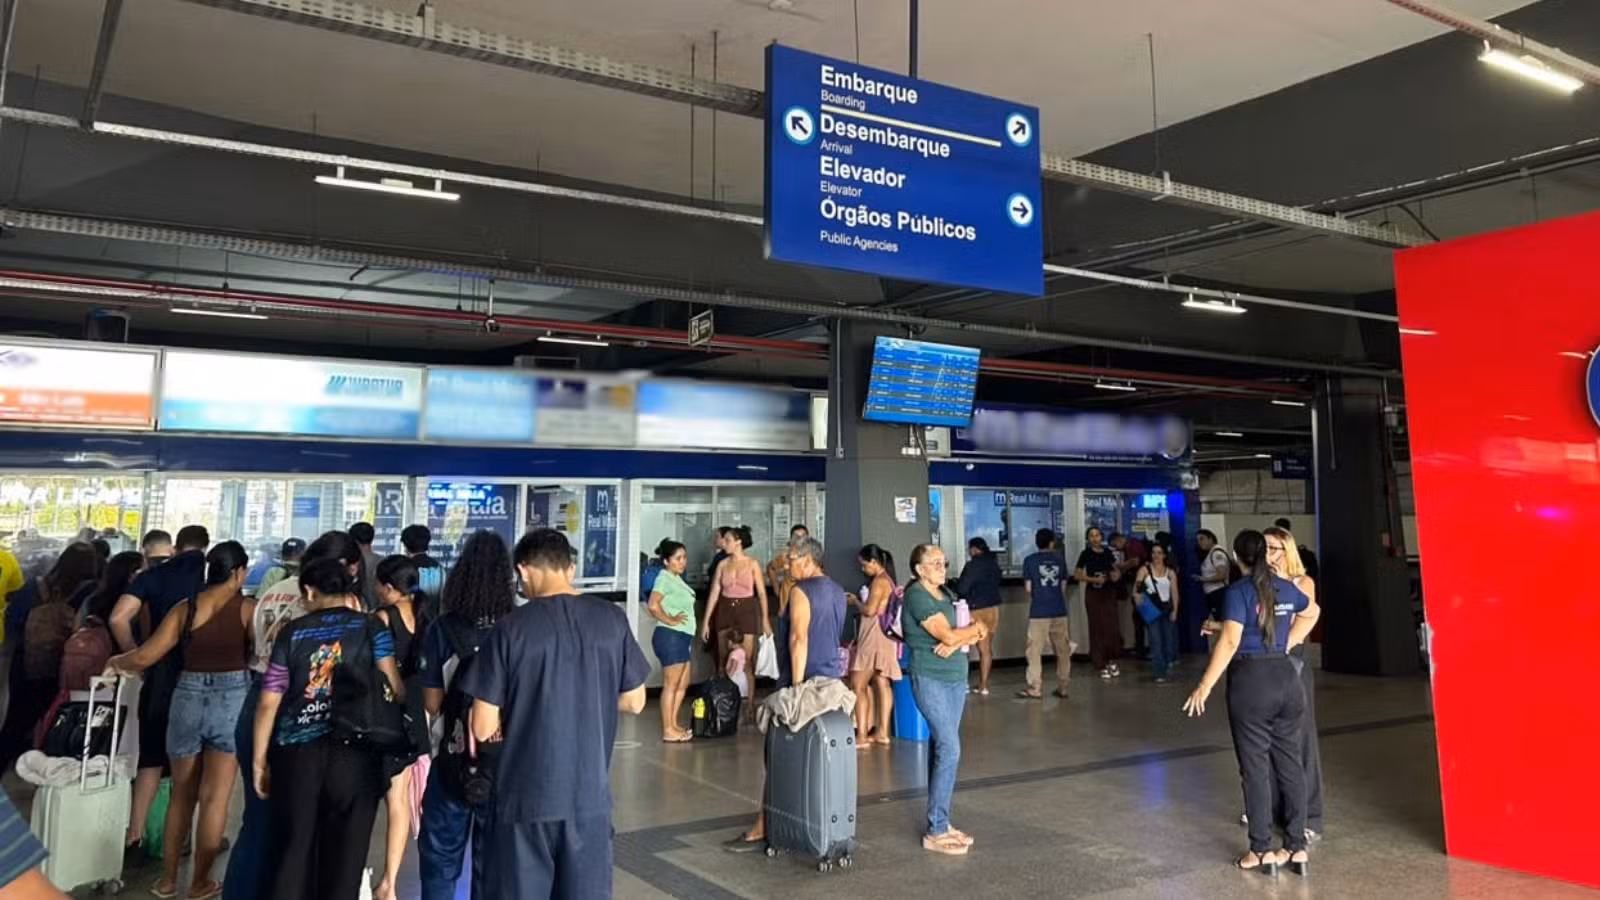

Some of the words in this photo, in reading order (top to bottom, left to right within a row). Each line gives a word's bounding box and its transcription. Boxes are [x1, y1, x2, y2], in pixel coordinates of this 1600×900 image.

[821, 64, 918, 104] Embarque
[821, 89, 866, 111] Boarding
[820, 113, 950, 158] Desembarque
[820, 139, 853, 155] Arrival
[820, 155, 906, 188] Elevador
[820, 180, 863, 197] Elevator
[820, 195, 892, 228] Órgãos
[897, 211, 977, 241] Públicos
[820, 230, 851, 246] Public
[853, 235, 899, 253] Agencies
